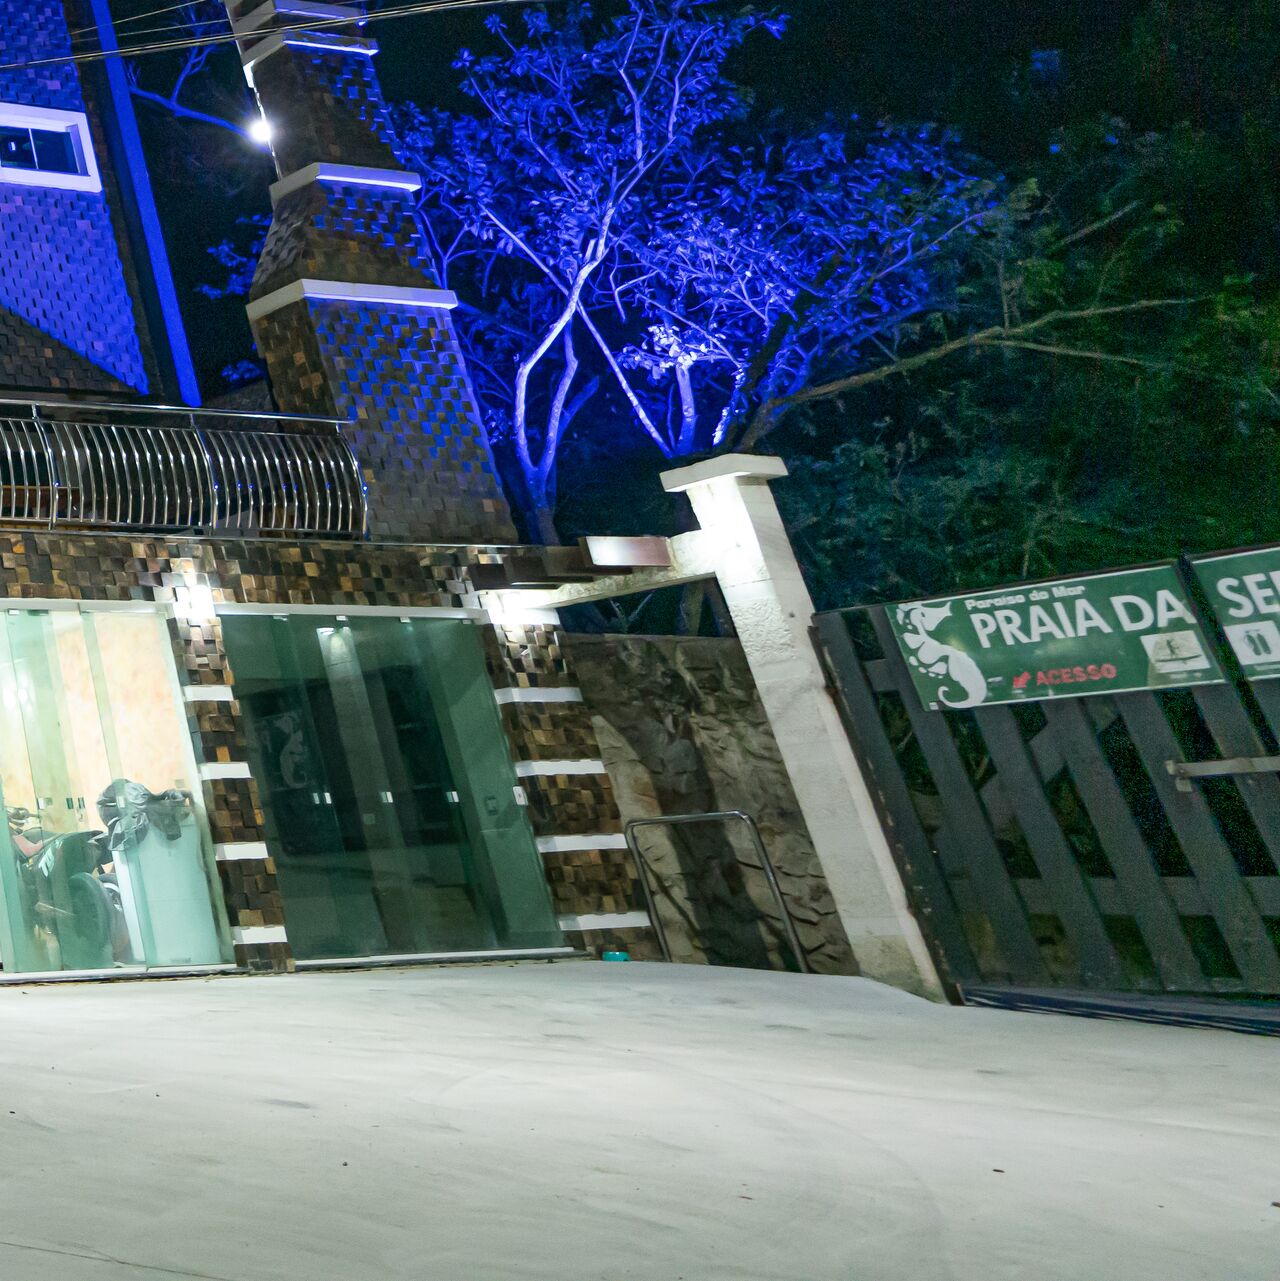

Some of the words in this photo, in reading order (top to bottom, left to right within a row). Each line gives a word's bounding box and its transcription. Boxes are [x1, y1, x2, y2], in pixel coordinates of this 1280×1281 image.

[1216, 570, 1280, 618] SE
[969, 598, 1114, 649] PRAIA
[1109, 589, 1198, 632] DA
[1036, 663, 1117, 686] ACESSO
